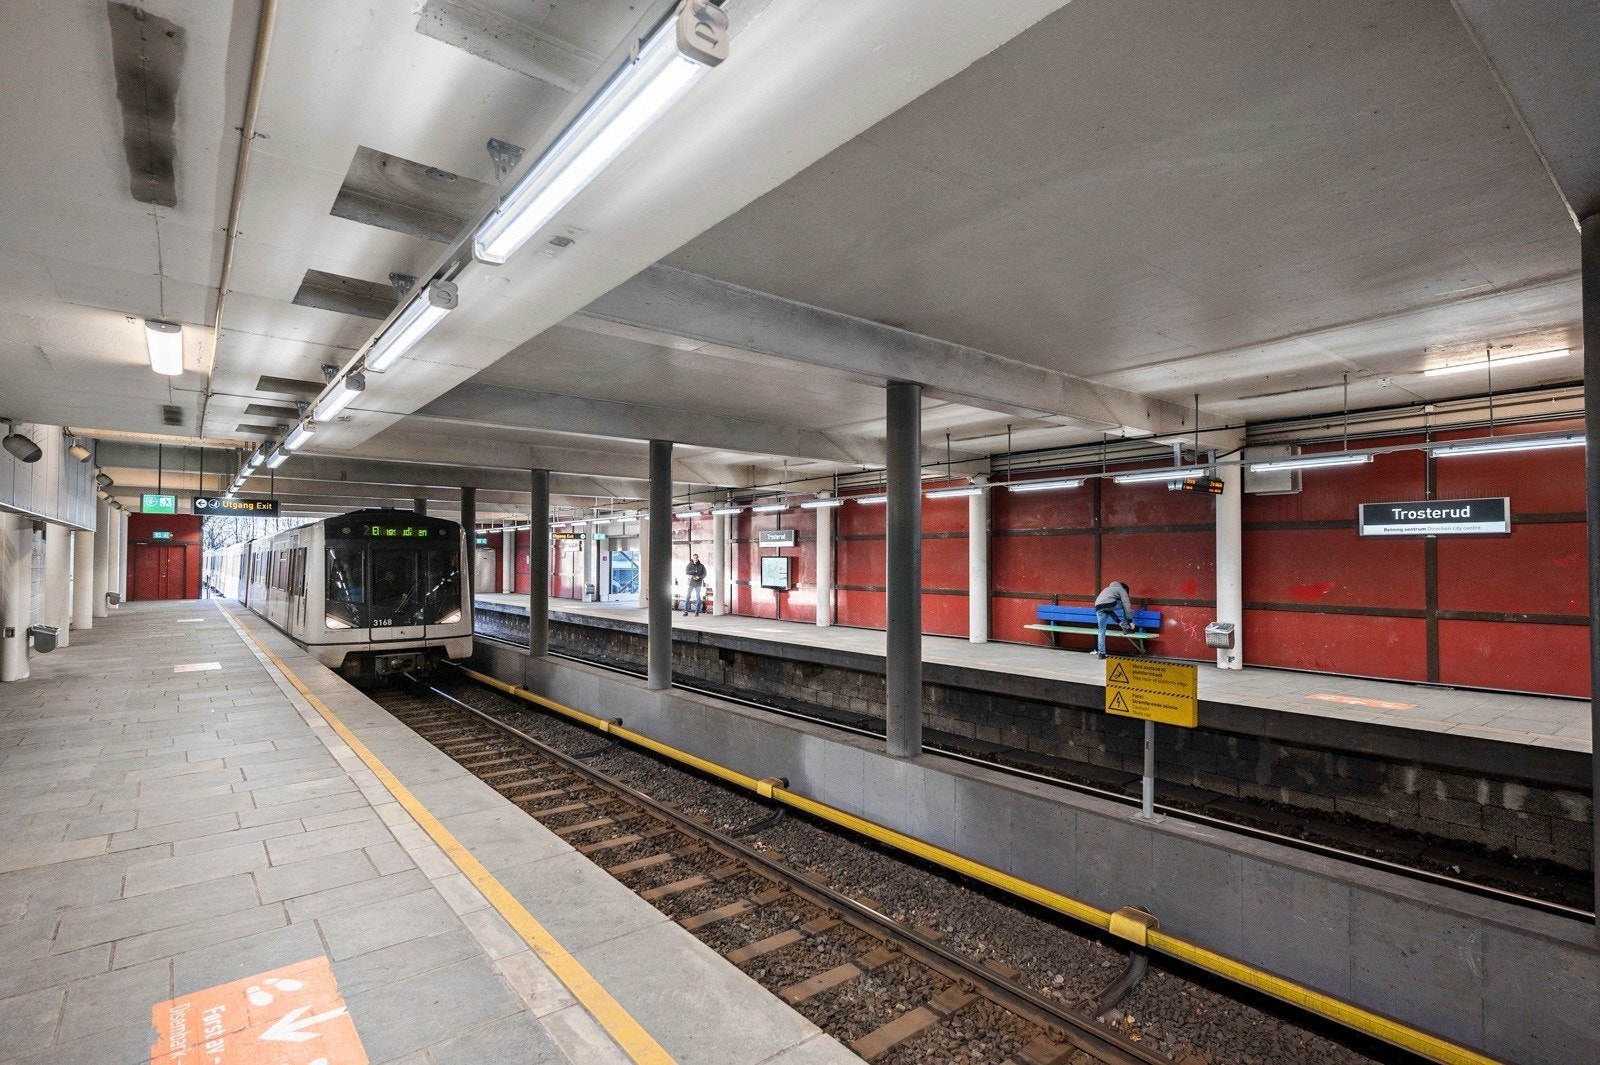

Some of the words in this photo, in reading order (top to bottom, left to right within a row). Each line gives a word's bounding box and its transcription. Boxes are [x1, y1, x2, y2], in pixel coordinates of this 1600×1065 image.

[222, 501, 254, 511] Utgang
[256, 502, 273, 510] Exit
[1392, 505, 1471, 519] Trosterud
[373, 619, 392, 627] 3168
[203, 1004, 227, 1039] Først
[169, 1002, 192, 1060] Disembark
[205, 1039, 226, 1054] av
